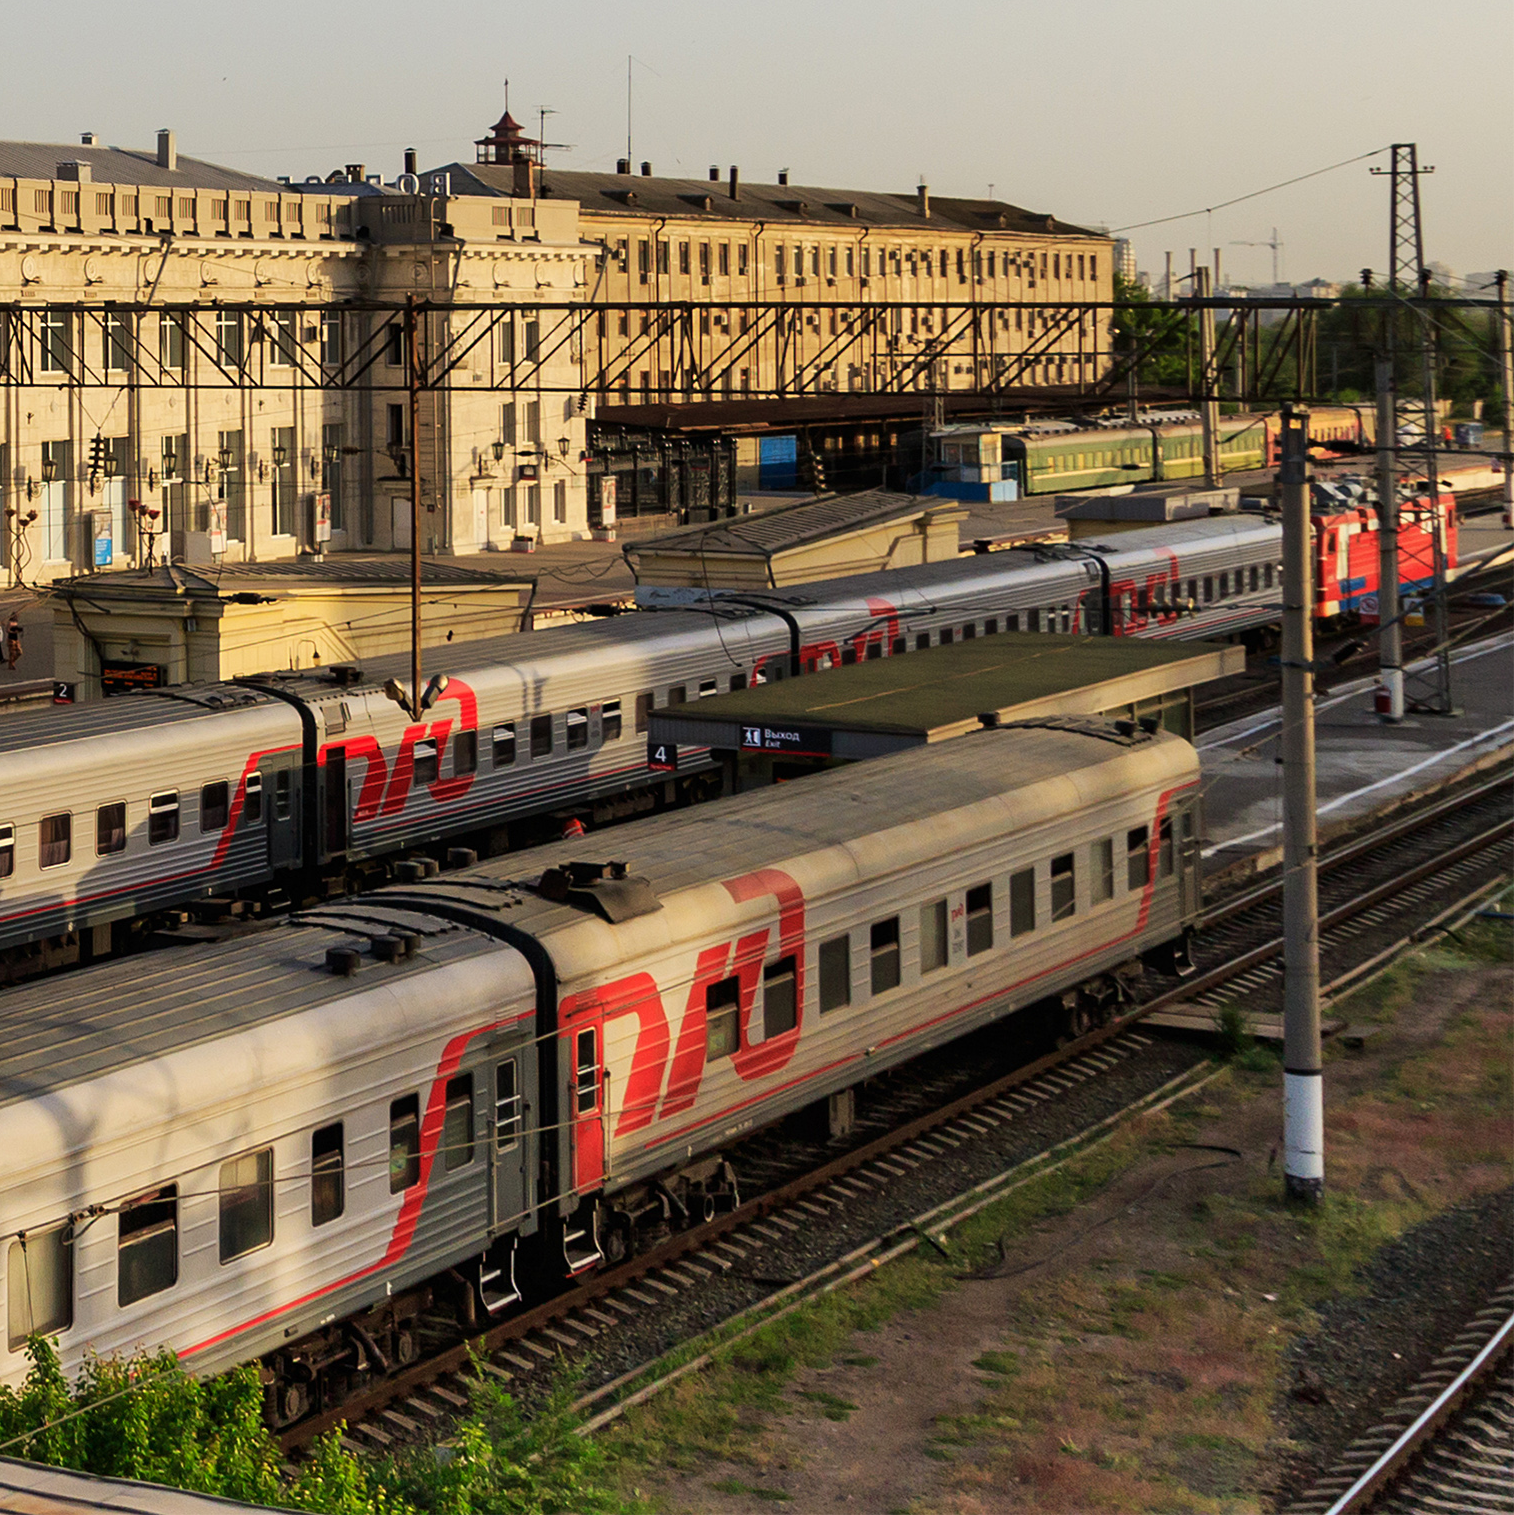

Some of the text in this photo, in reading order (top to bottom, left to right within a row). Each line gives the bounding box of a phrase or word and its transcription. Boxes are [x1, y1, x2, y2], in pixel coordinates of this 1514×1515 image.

[59, 683, 67, 697] 2
[764, 729, 801, 743] Выход
[654, 746, 667, 763] 4
